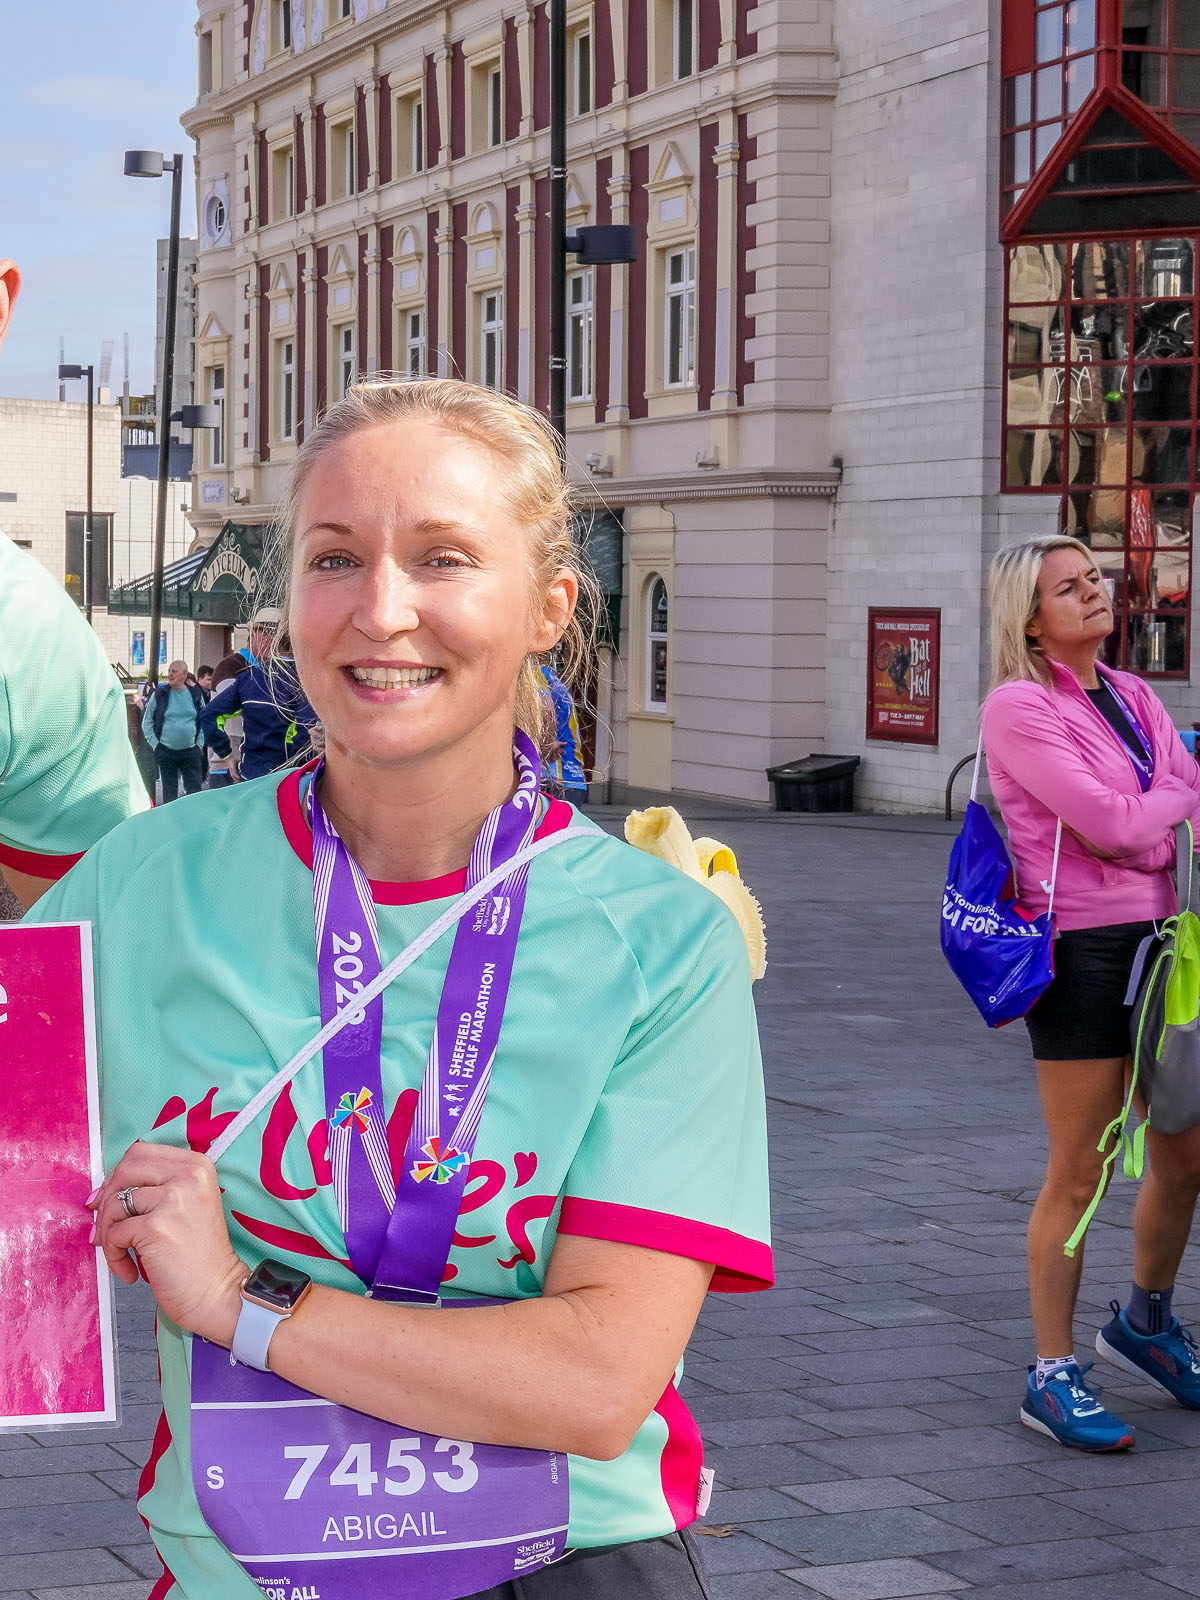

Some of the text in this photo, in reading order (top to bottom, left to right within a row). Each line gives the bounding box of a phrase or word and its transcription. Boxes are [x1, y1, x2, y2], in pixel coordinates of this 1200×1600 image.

[211, 553, 247, 581] LYCEUM
[909, 637, 931, 667] Bat
[909, 667, 931, 701] Hell
[472, 898, 488, 932] Sheffield
[961, 915, 999, 935] FOR
[461, 962, 496, 1079] HALF MARATHON
[448, 1012, 472, 1077] SHEFFIELD
[206, 1437, 480, 1500] S 7453
[550, 1456, 558, 1485] ABIGAIL
[322, 1511, 447, 1542] ABIGAIL
[517, 1538, 555, 1554] Sheffield
[254, 1576, 291, 1585] mlinson's
[260, 1585, 320, 1600] OR ALL
